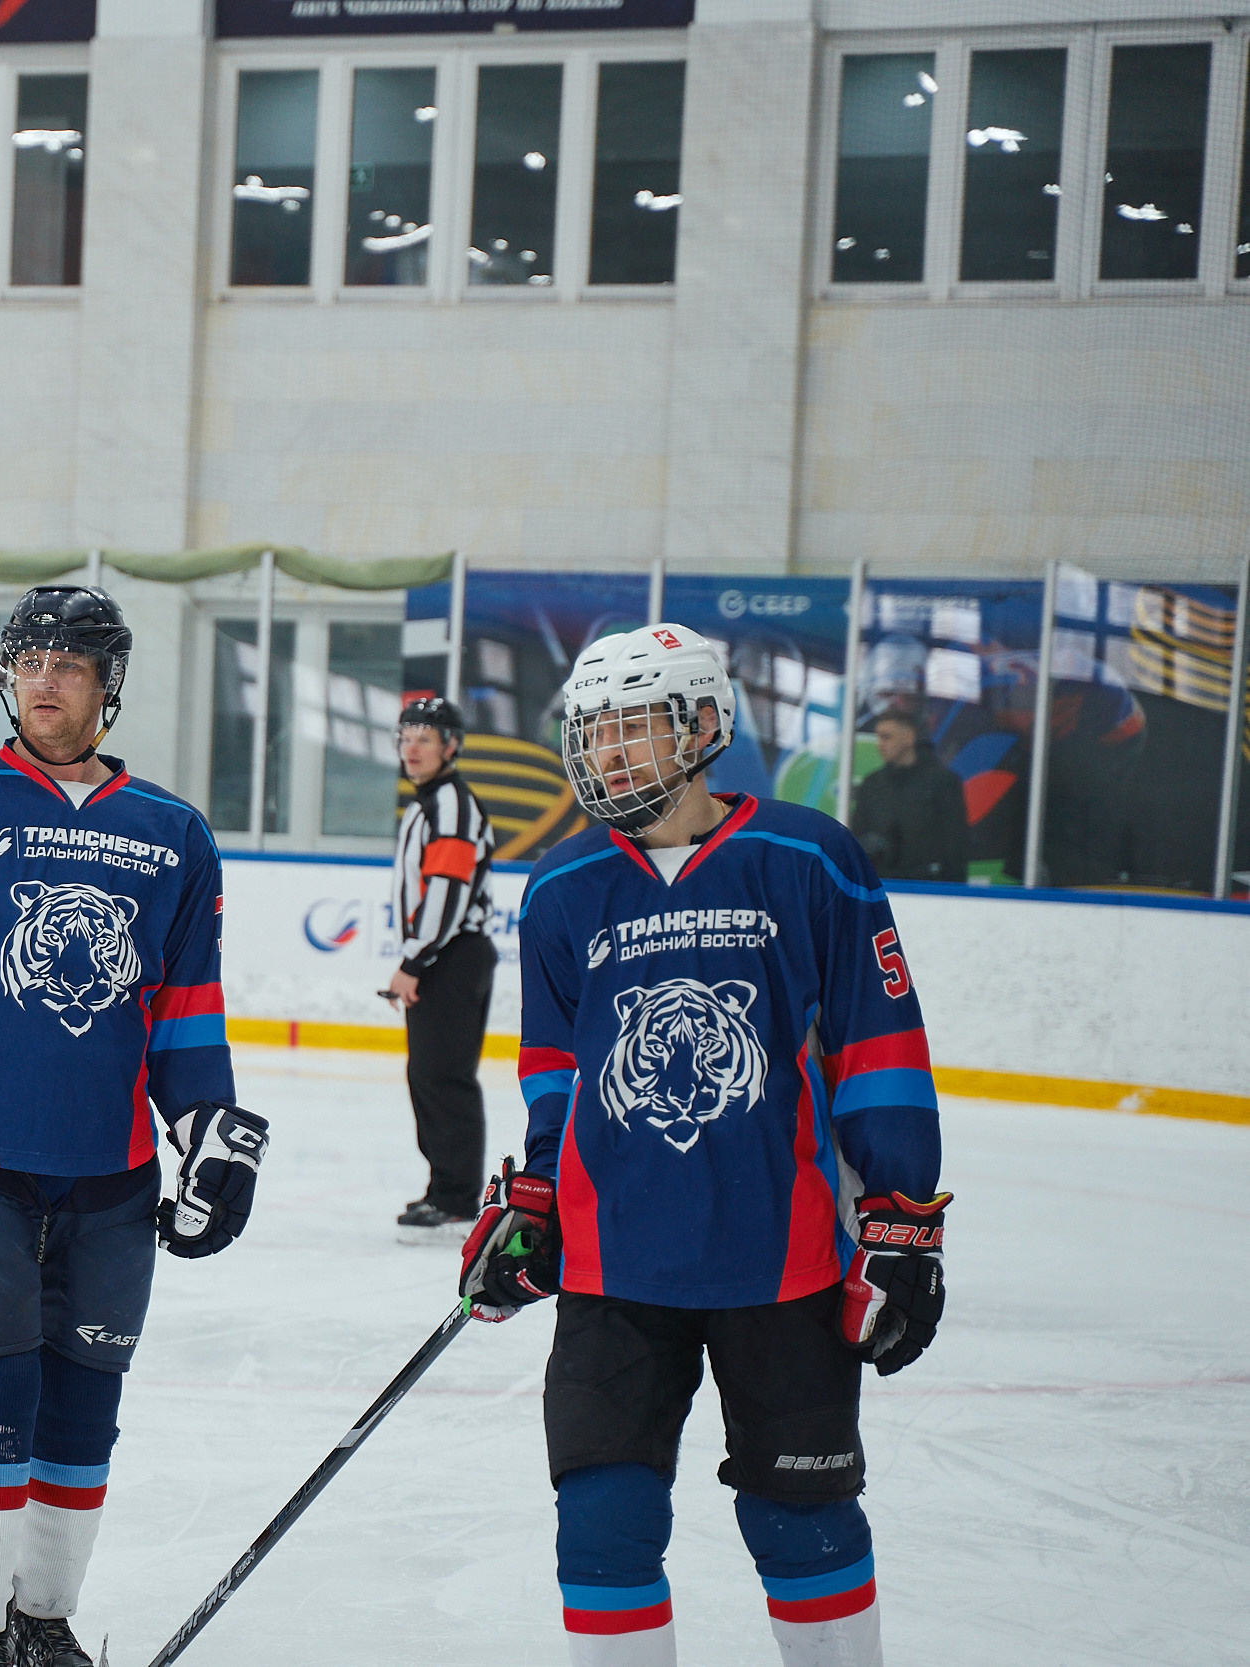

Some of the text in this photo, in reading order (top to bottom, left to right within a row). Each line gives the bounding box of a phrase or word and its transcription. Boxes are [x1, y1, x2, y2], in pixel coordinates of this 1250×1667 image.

[751, 594, 812, 616] СБЕР
[575, 675, 609, 690] CCM
[689, 676, 715, 687] CCM
[22, 826, 180, 867] ТРАНСНЕФТЬ
[23, 846, 159, 877] ДАЛЬНИЙ ВОСТОК
[616, 909, 778, 943] ТРАНСНЕФТЬ
[619, 930, 768, 961] ДАЛЬНИЙ ВОСТОК
[872, 927, 914, 999] 5
[775, 1452, 854, 1469] BAUER
